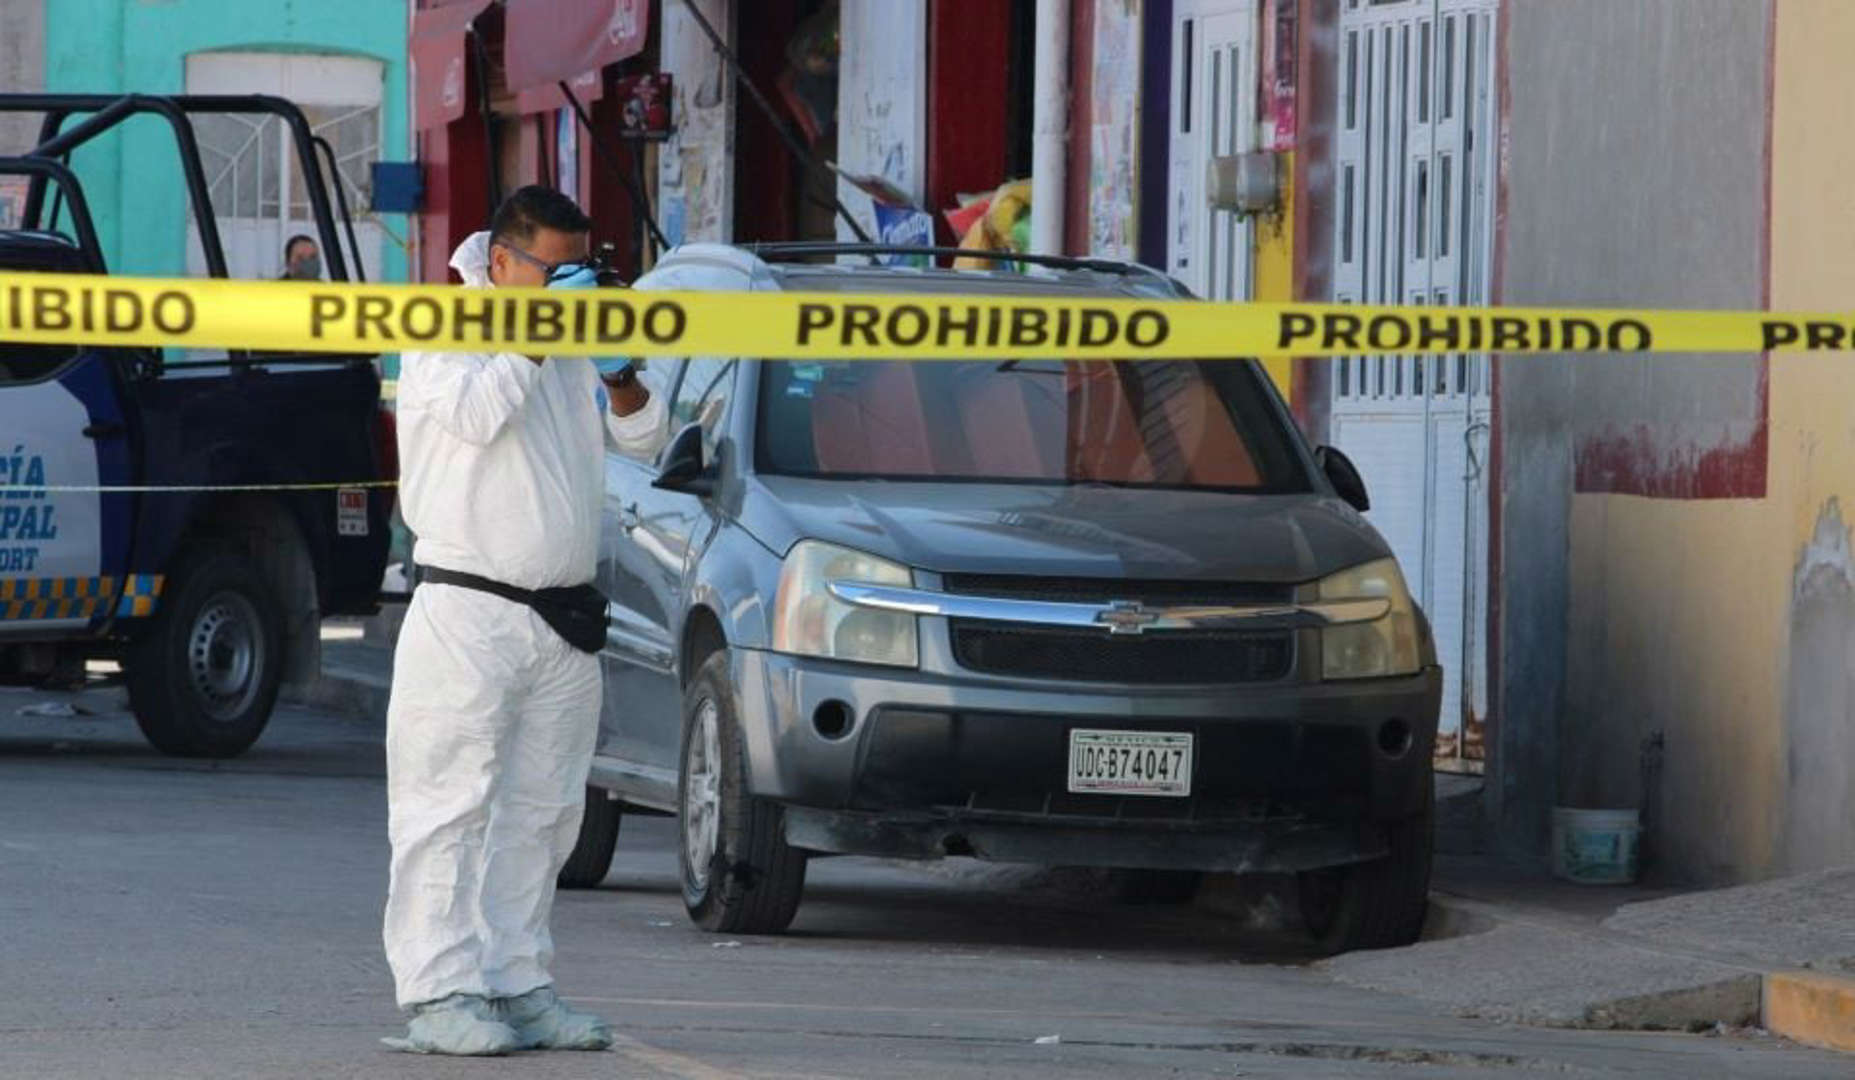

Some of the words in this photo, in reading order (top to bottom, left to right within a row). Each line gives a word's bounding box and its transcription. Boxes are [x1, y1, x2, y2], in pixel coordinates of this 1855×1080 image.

[309, 294, 687, 344] PROHIBIDO
[796, 303, 1171, 348] PROHIBIDO
[1276, 312, 1653, 351] PROHIBIDO
[1761, 322, 1855, 351] PR
[0, 505, 57, 540] PAL
[1076, 746, 1183, 780] UDC-B74047
